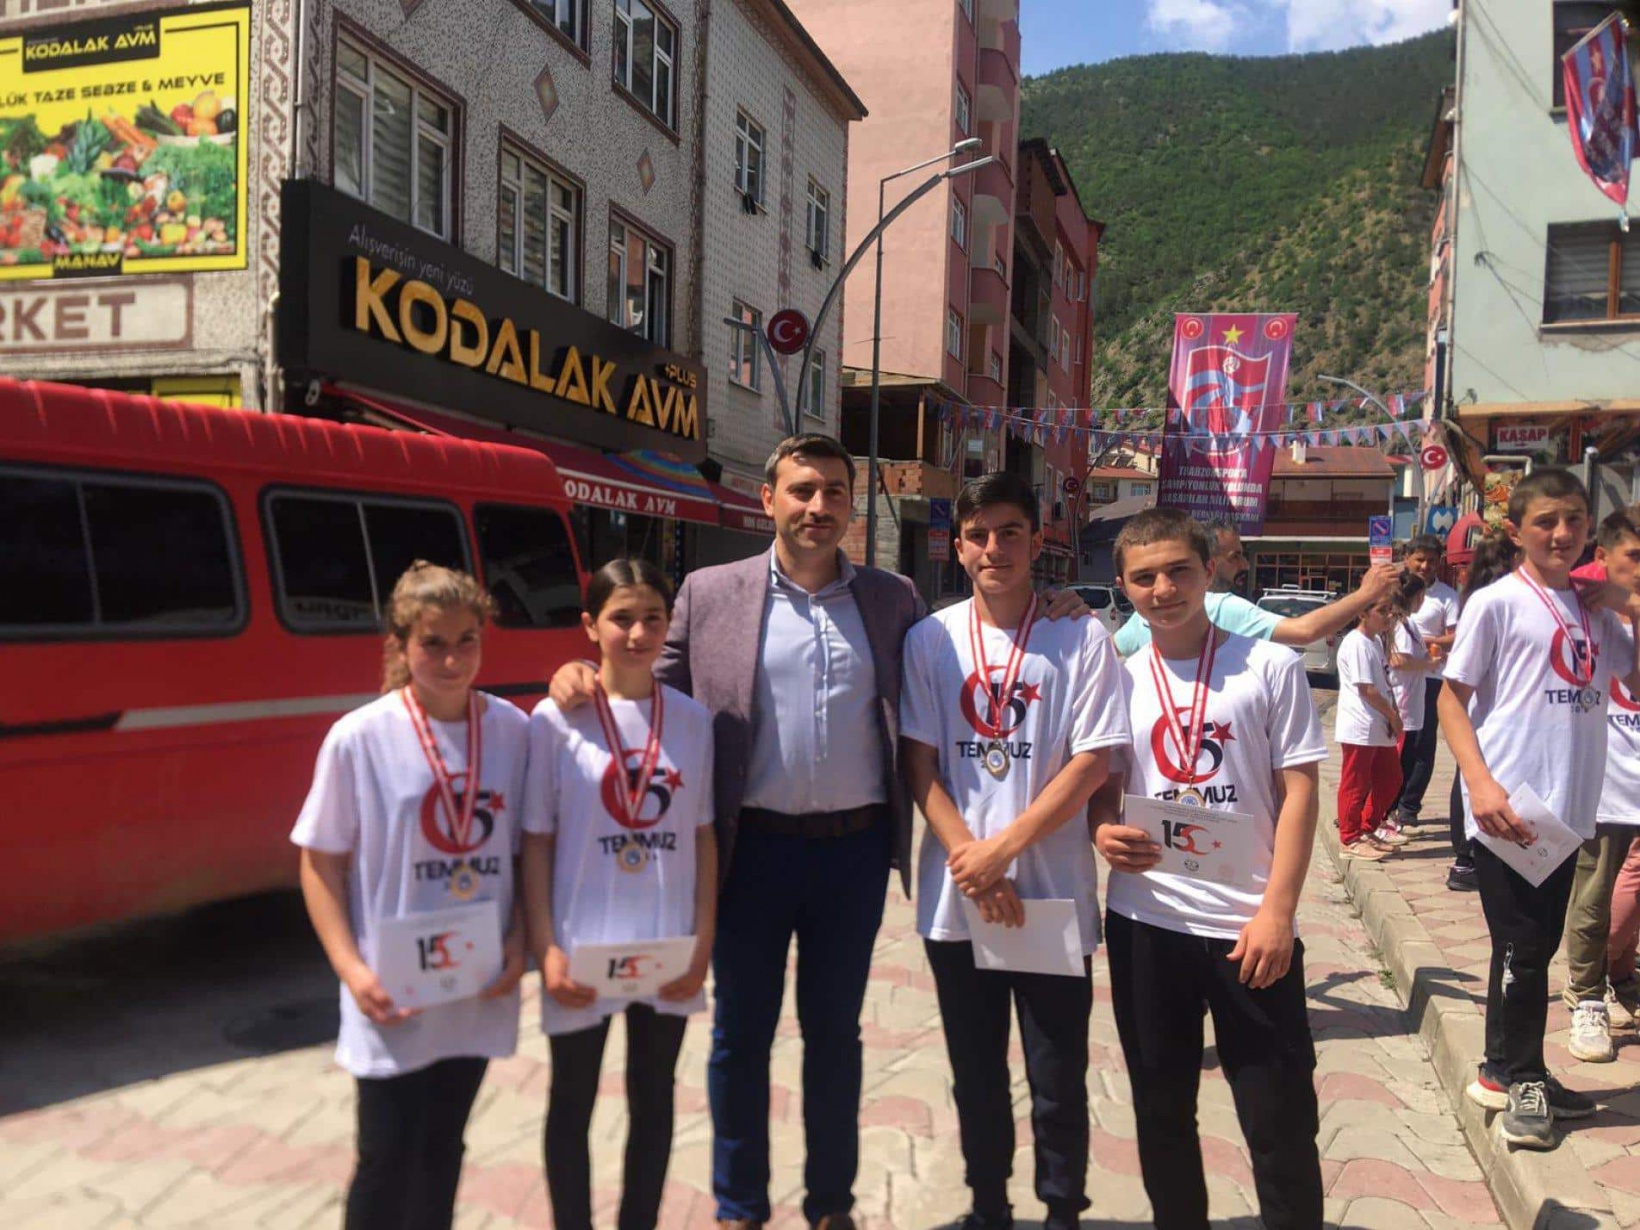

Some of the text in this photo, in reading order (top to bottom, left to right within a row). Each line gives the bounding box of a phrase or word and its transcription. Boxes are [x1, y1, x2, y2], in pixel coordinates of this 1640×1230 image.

[26, 31, 156, 60] KODALAK AVM
[33, 86, 76, 104] TAZE
[81, 81, 136, 98] SEBZE
[142, 80, 152, 92] &
[158, 72, 225, 90] MEYVE
[55, 253, 120, 269] MANAV
[419, 261, 445, 284] yeni
[446, 270, 474, 295] yüzü
[355, 255, 699, 440] KODALAK AVM
[1500, 428, 1547, 442] KASAP
[562, 479, 676, 515] ODALAK AVM
